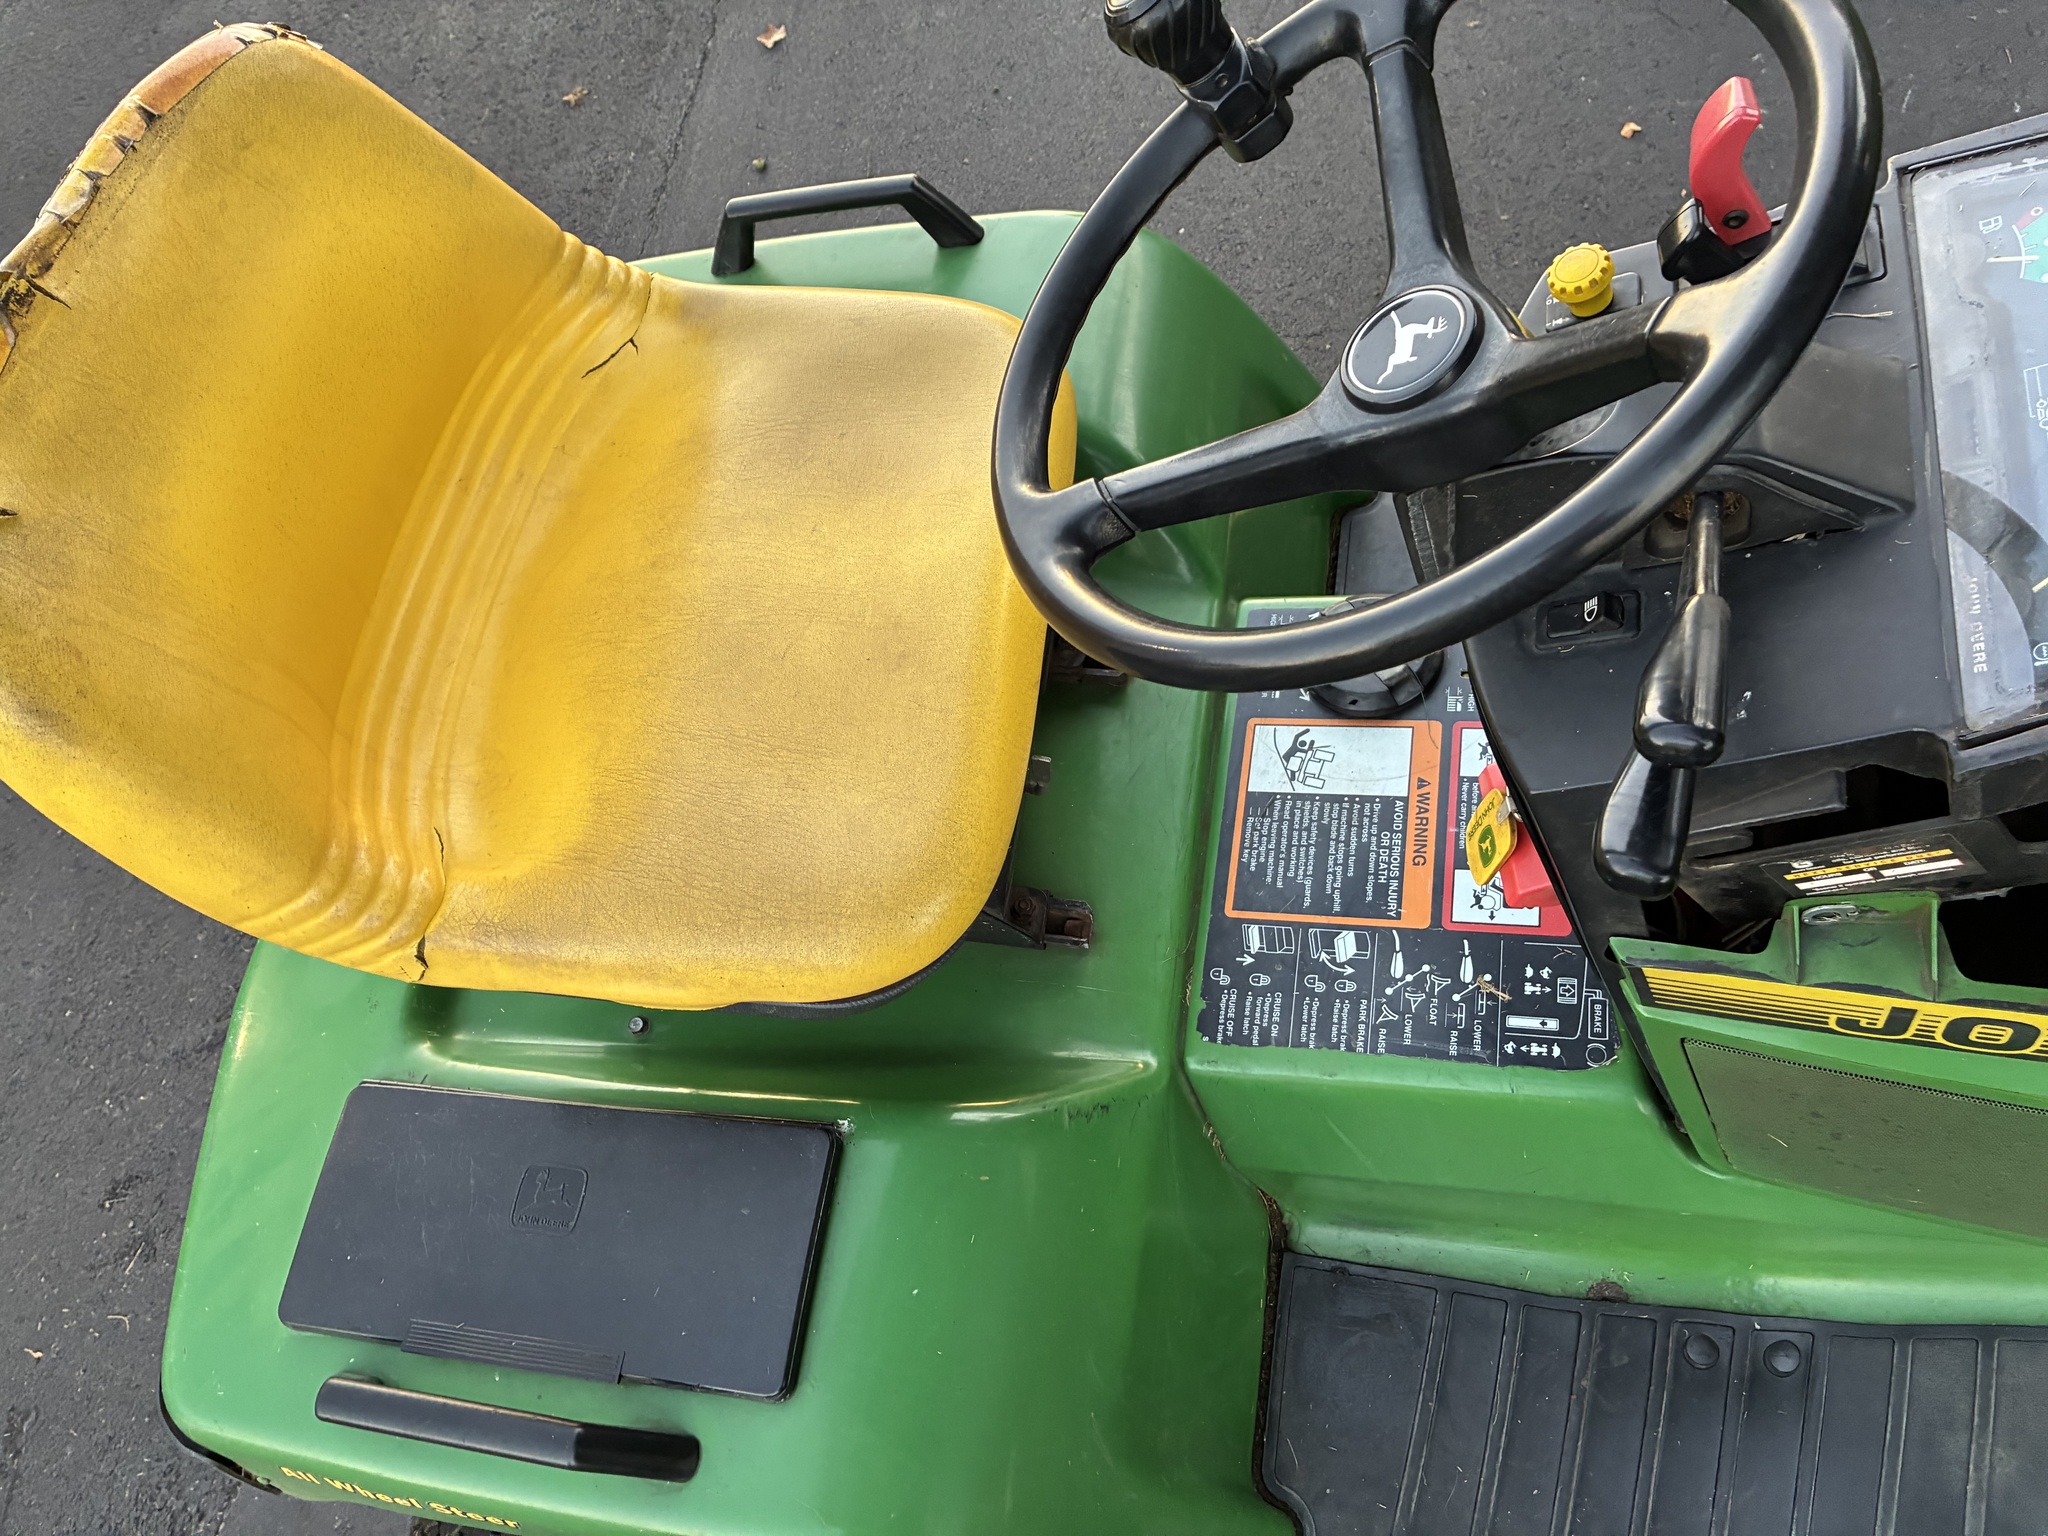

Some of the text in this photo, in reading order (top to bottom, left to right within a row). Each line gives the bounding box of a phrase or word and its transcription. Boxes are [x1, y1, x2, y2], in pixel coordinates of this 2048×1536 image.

[1471, 782, 1480, 804] before
[1293, 809, 1302, 829] place
[1312, 801, 1320, 820] Keep
[1321, 802, 1330, 824] slowly
[1372, 803, 1381, 823] Drive
[1459, 802, 1467, 820] carry
[1482, 797, 1495, 820] JOHN
[1241, 817, 1254, 862] Remove key
[1252, 831, 1260, 848] park
[1259, 818, 1271, 862] Stop engine
[1300, 831, 1308, 845] and
[1308, 822, 1318, 844] safety
[1339, 810, 1348, 841] machine
[1347, 803, 1360, 877] Avoid sudden turns
[1361, 817, 1369, 842] across
[1370, 825, 1378, 834] up
[1412, 792, 1430, 866] WARNING
[1458, 821, 1466, 849] children
[1266, 800, 1282, 885] When leaving machine:
[1276, 800, 1292, 888] Read operator's manual
[1325, 803, 1339, 894] stop blade and back down
[1336, 843, 1345, 864] stops
[1370, 836, 1378, 850] and
[1378, 831, 1390, 883] OR DEATH
[1250, 850, 1258, 871] brake
[1287, 846, 1298, 877] working
[1296, 846, 1308, 882] switches)
[1307, 846, 1316, 875] devices
[1368, 852, 1377, 873] down
[1387, 800, 1404, 917] AVOID SERIOUS INJURY
[1793, 869, 1826, 878] NEXT
[1836, 859, 1895, 872] SERVICE
[1333, 866, 1343, 887] going
[1218, 994, 1228, 1024] Depress
[1228, 988, 1237, 1018] CRUISE
[1242, 996, 1252, 1035] Raise latch
[1262, 997, 1271, 1027] Depress
[1271, 992, 1282, 1037] CRUISE ON
[1429, 998, 1438, 1026] FLOAT
[1251, 997, 1263, 1046] forward pedal
[1300, 1000, 1310, 1042] Lower latch
[1308, 1001, 1319, 1049] Depress brak
[1331, 1002, 1340, 1042] Raise latch
[1340, 1003, 1349, 1034] Depress
[1356, 999, 1367, 1053] PARK BRAKE
[1403, 1014, 1412, 1045] LOWER
[1593, 1004, 1602, 1034] BRAKE
[1834, 1005, 2042, 1053] JO
[1378, 1028, 1386, 1054] RAISE
[1449, 1030, 1458, 1056] RAISE
[1473, 1020, 1482, 1051] LOWER
[280, 1466, 521, 1530] All Wheel Steer
